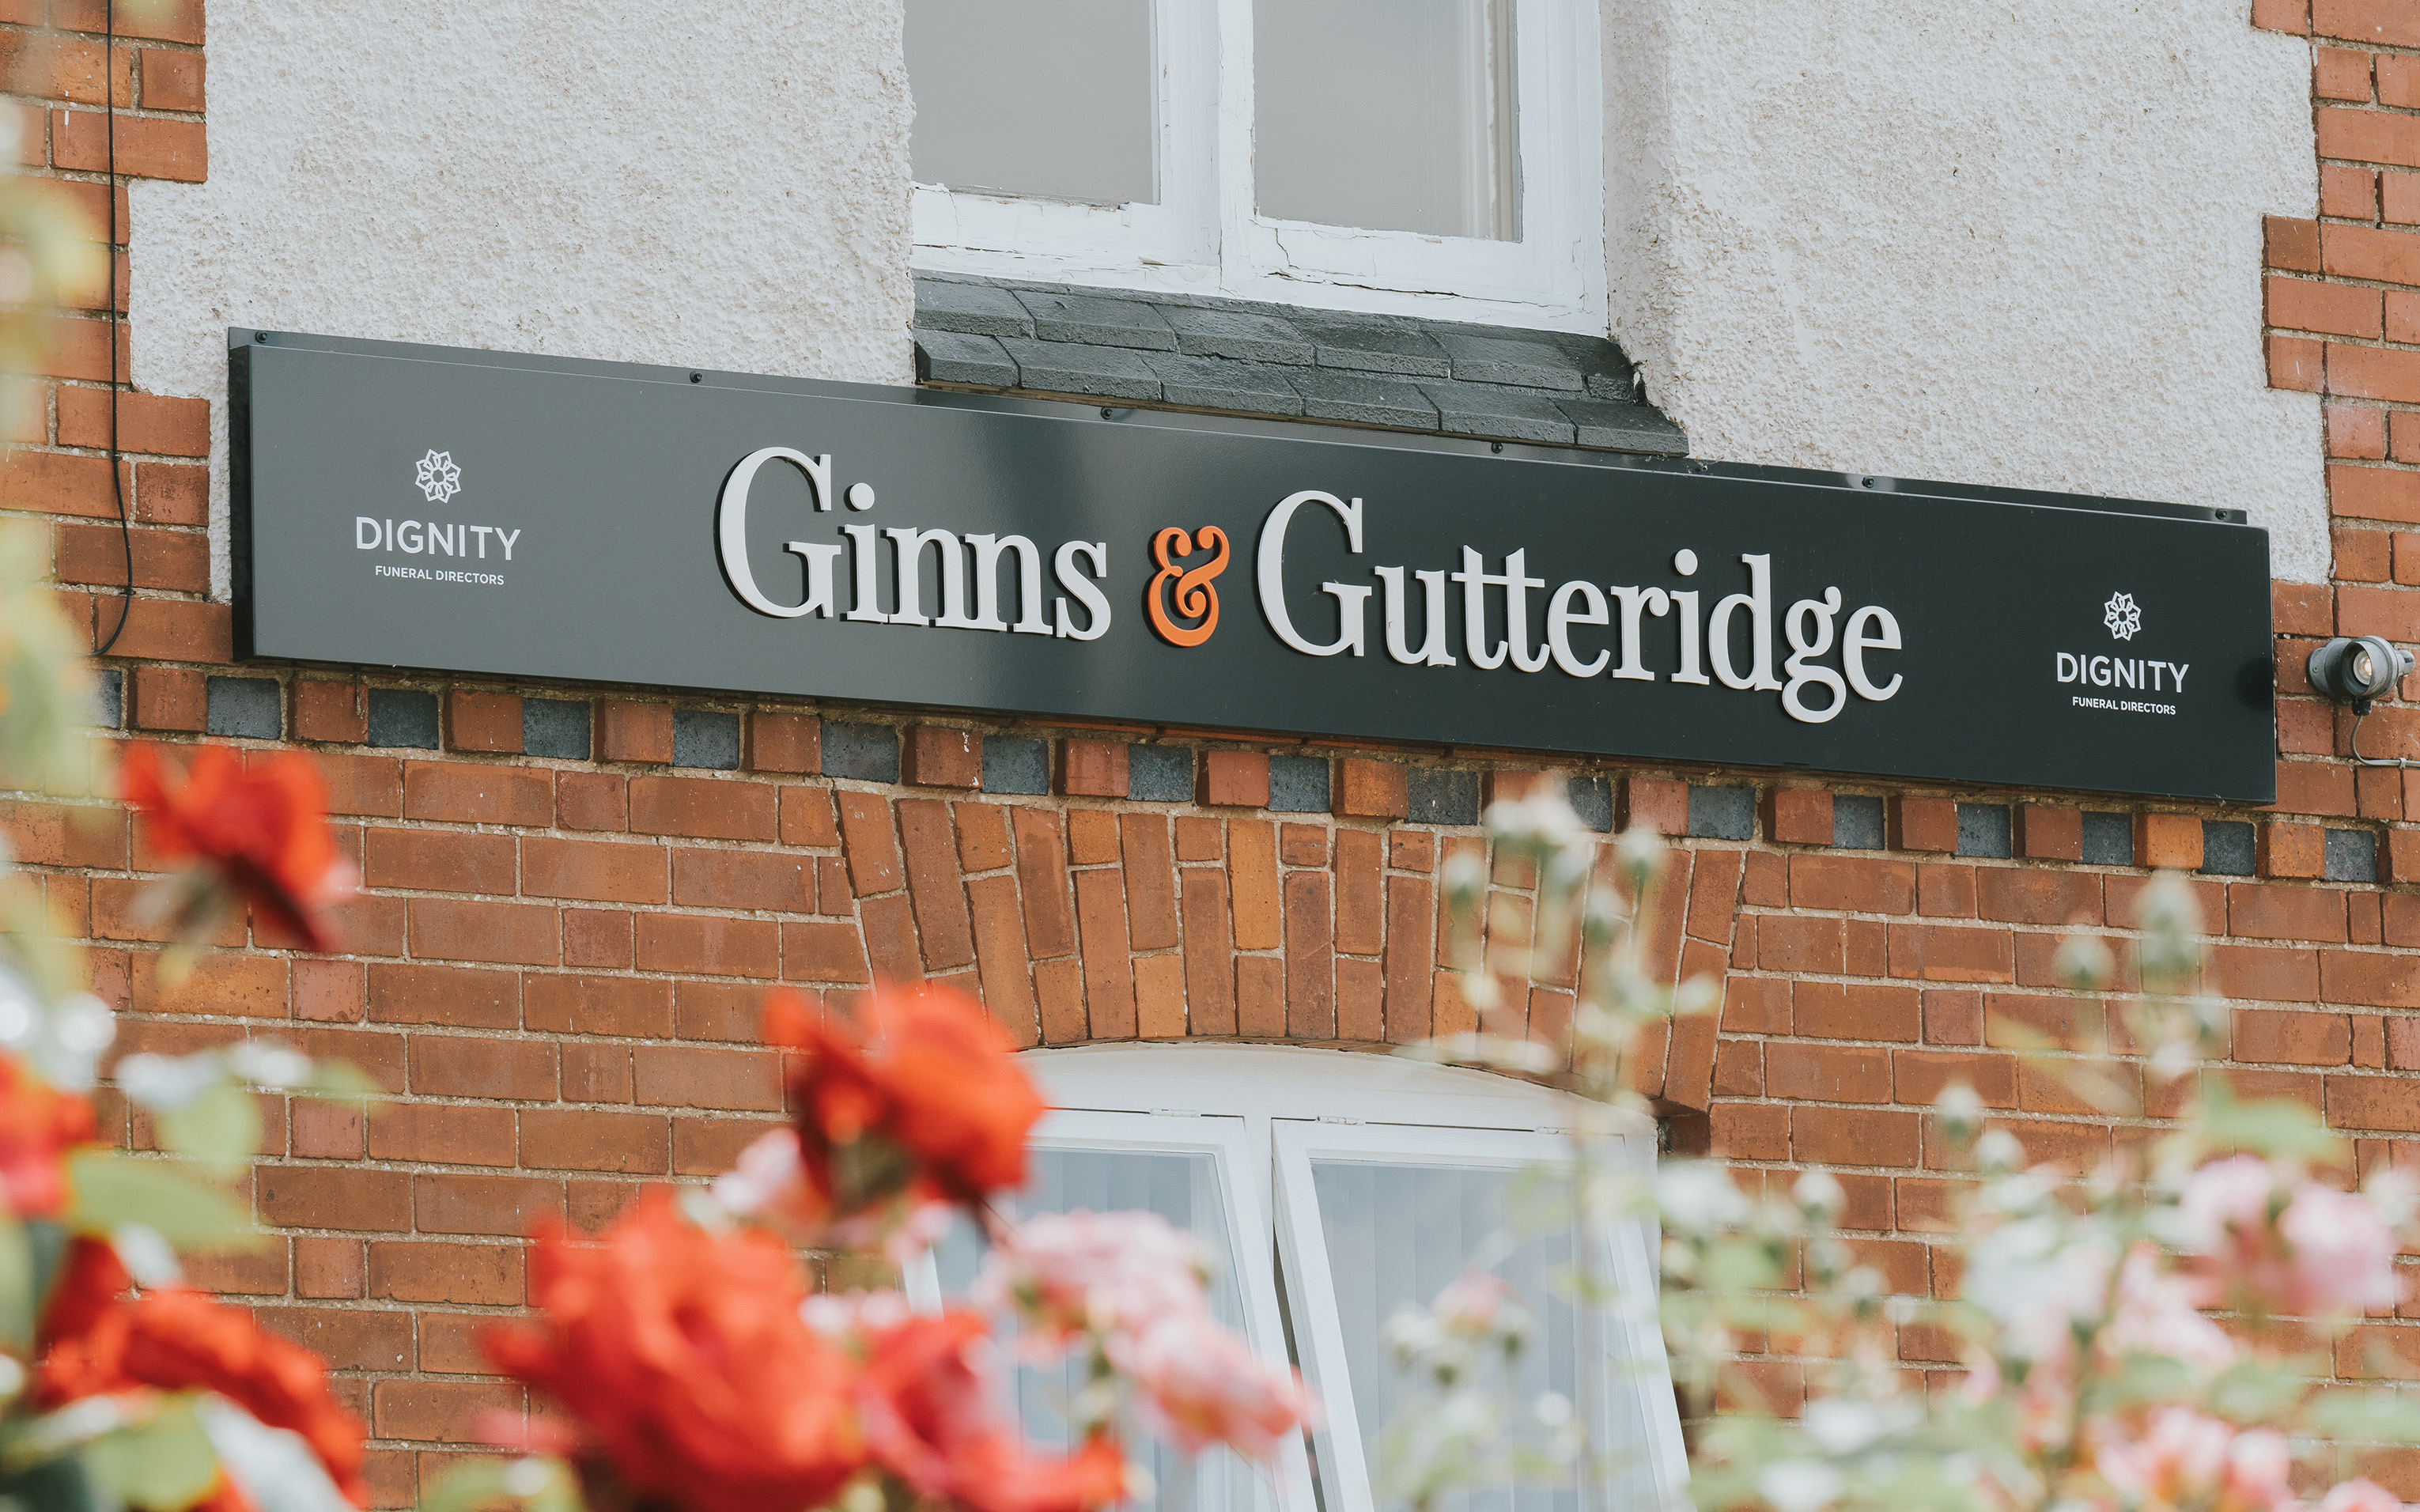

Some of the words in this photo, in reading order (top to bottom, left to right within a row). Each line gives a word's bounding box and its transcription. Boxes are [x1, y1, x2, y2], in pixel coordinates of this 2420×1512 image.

[356, 516, 521, 561] DIGNITY
[375, 565, 433, 580] FUNERAL
[435, 569, 505, 586] DIRECTORS
[718, 445, 1112, 642] Ginns
[1146, 524, 1231, 648] &
[1256, 489, 1904, 724] Gutteridge
[2056, 652, 2191, 694] DIGNITY
[2072, 696, 2119, 710] FUNERAL
[2120, 701, 2176, 715] DIRECTORS
